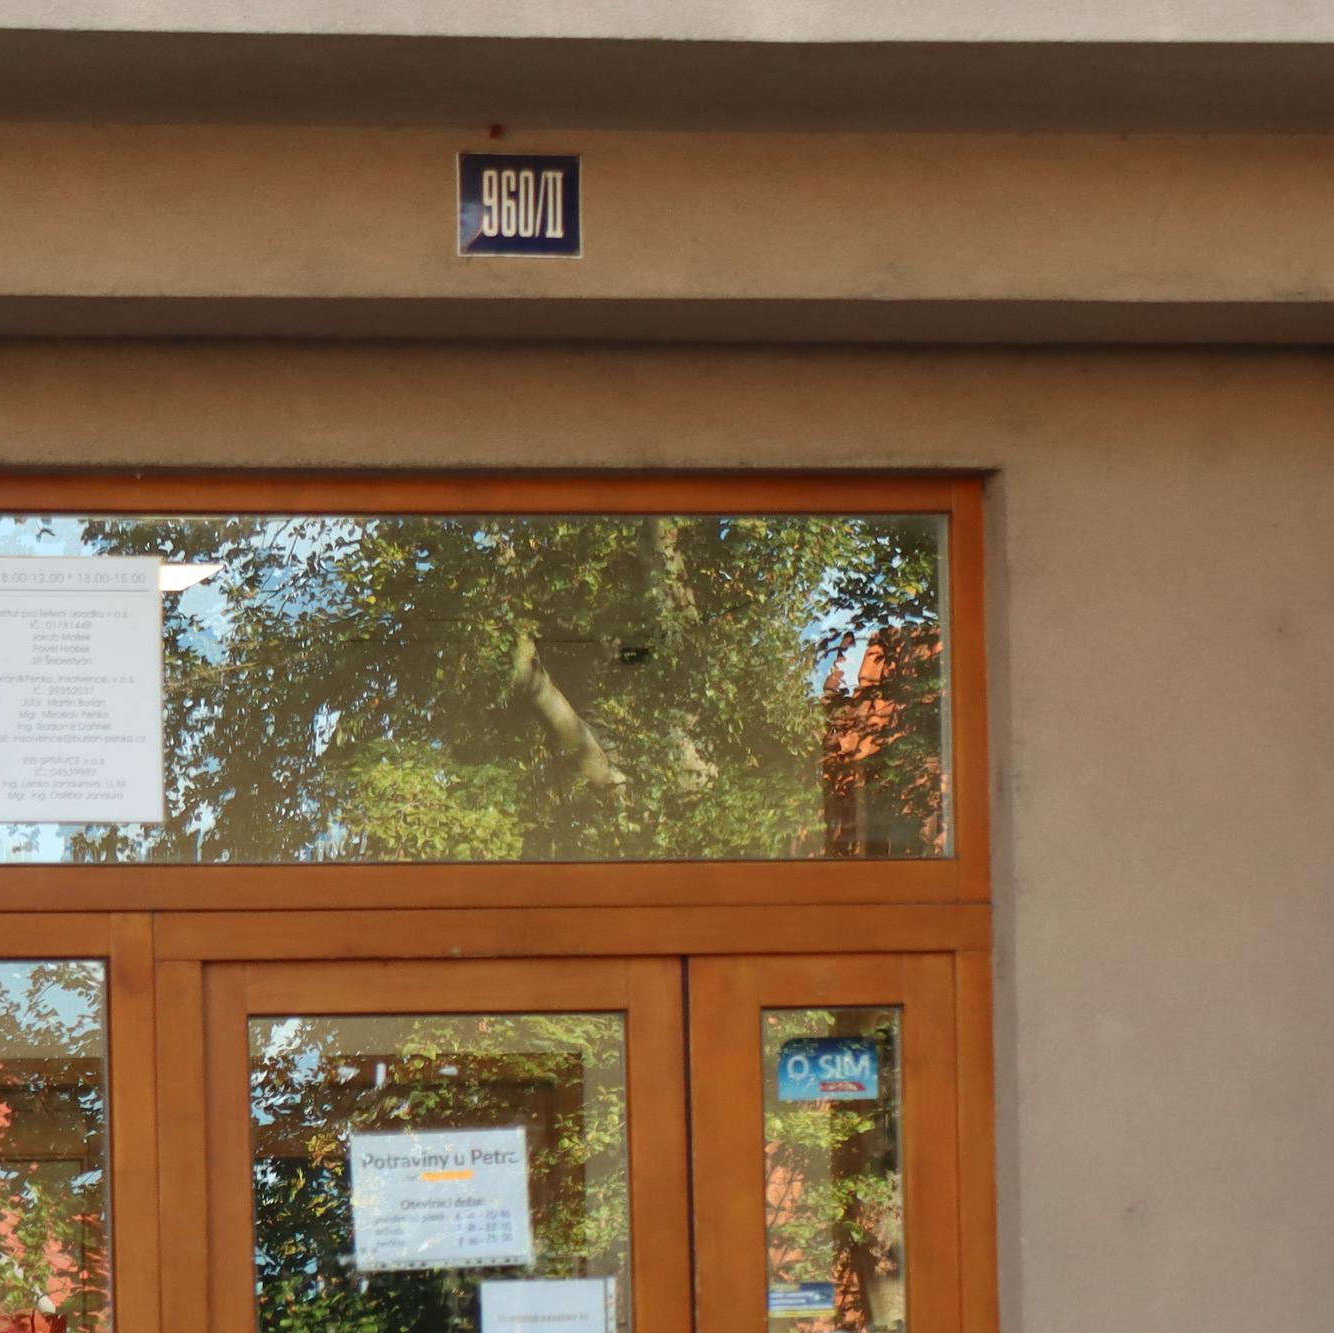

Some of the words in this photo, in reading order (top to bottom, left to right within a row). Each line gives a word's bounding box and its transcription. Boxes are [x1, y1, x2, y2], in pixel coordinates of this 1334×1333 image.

[482, 169, 564, 238] 960/II
[362, 1151, 449, 1170] Potraviny
[455, 1155, 465, 1166] u
